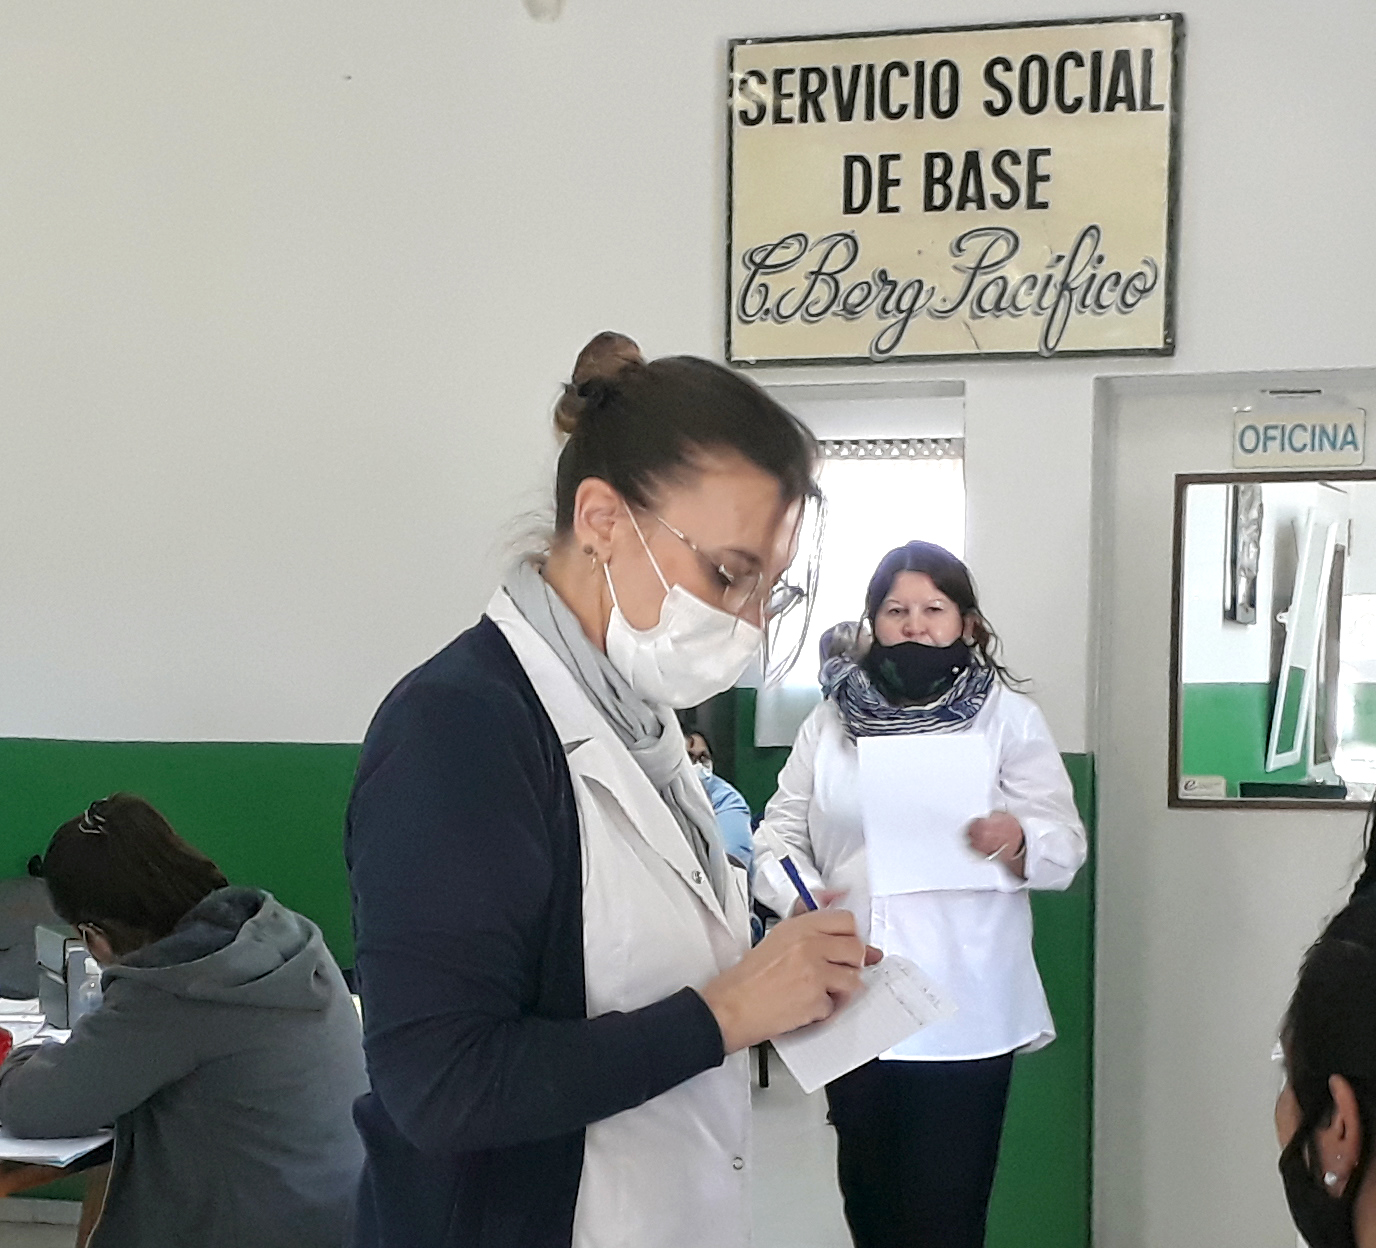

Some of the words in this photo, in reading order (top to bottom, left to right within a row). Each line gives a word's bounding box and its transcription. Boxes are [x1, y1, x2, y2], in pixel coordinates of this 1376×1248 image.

[737, 58, 961, 127] SERVICIO
[983, 48, 1164, 117] SOCIAL
[842, 153, 902, 214] DE
[924, 147, 1053, 213] BASE
[928, 224, 1158, 357] Pacífico
[1238, 422, 1360, 454] OFICINA
